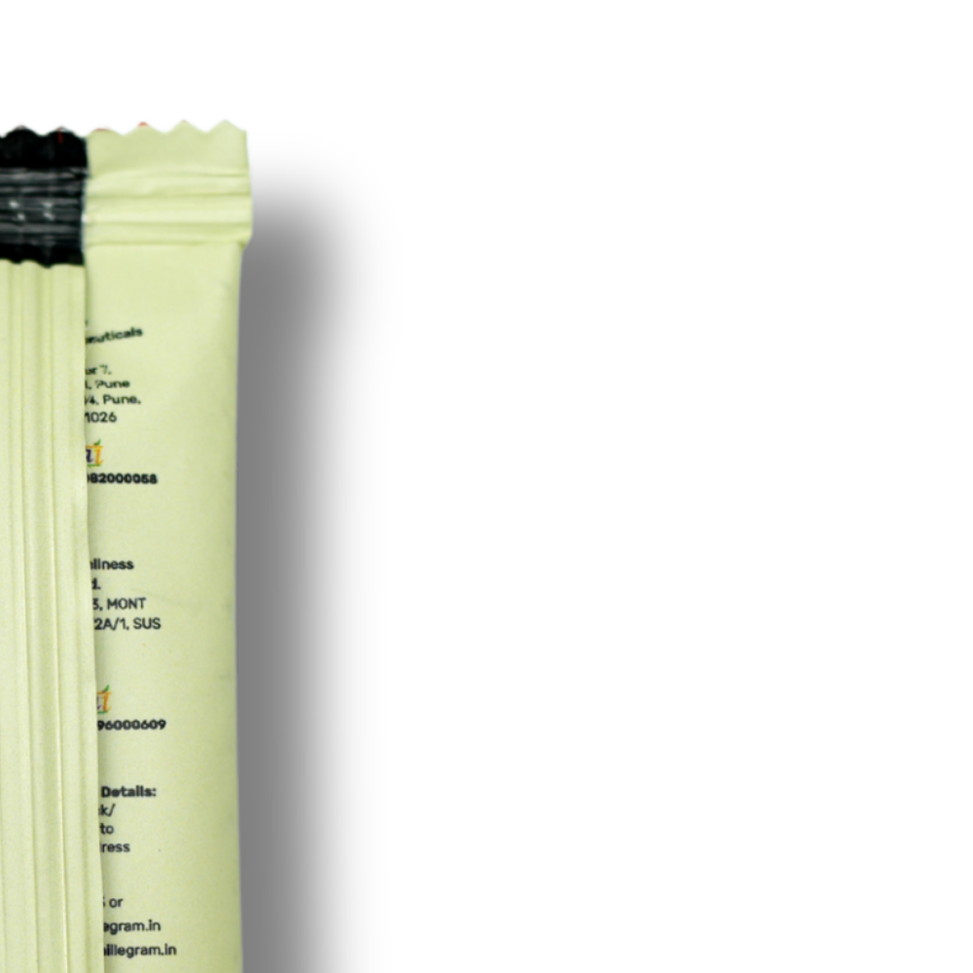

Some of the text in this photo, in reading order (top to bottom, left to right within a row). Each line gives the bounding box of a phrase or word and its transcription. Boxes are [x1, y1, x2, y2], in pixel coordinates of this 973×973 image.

[107, 597, 146, 610] MONT
[133, 617, 161, 629] SUS
[101, 785, 157, 798] Details:
[109, 898, 123, 908] or
